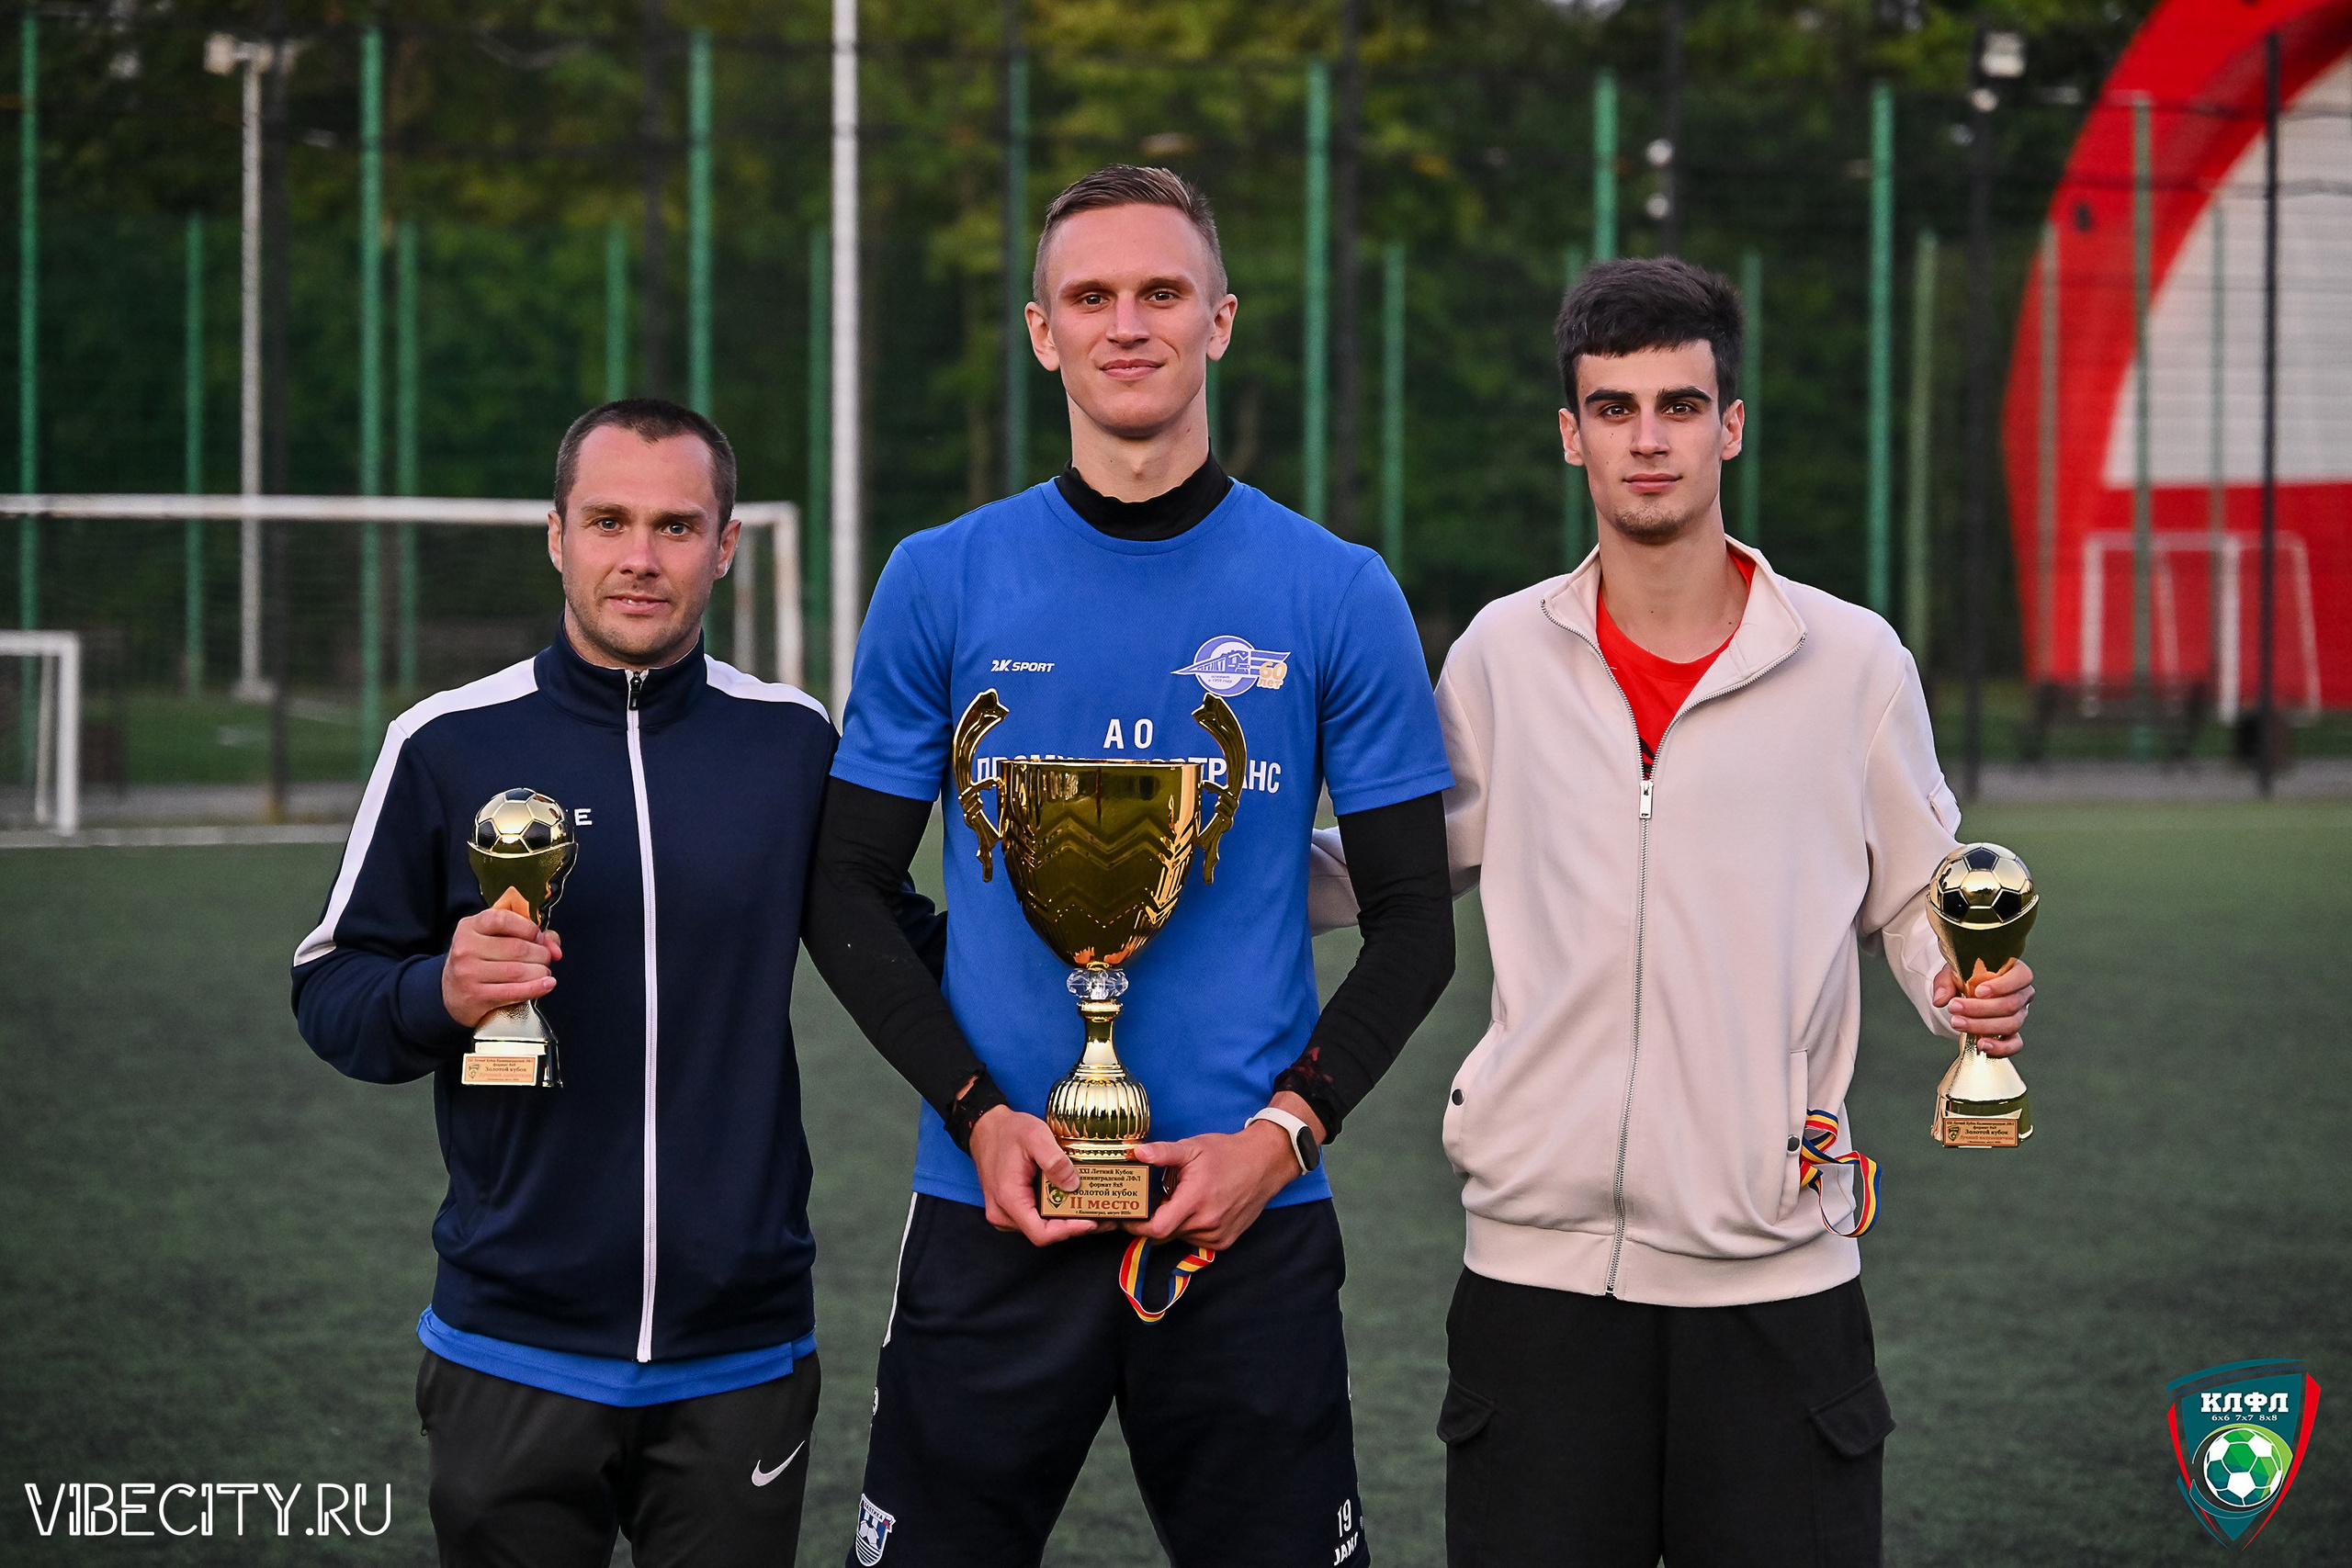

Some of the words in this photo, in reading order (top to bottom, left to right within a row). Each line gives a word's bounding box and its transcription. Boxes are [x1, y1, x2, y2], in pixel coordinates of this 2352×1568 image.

[990, 659, 1012, 671] 2K
[1012, 661, 1056, 672] SPORT
[1259, 661, 1287, 680] 60
[1259, 679, 1283, 688] лет
[1112, 1189, 1138, 1198] кубок
[1069, 1196, 1082, 1209] II
[1087, 1200, 1140, 1210] место
[1337, 1498, 1352, 1539] 19
